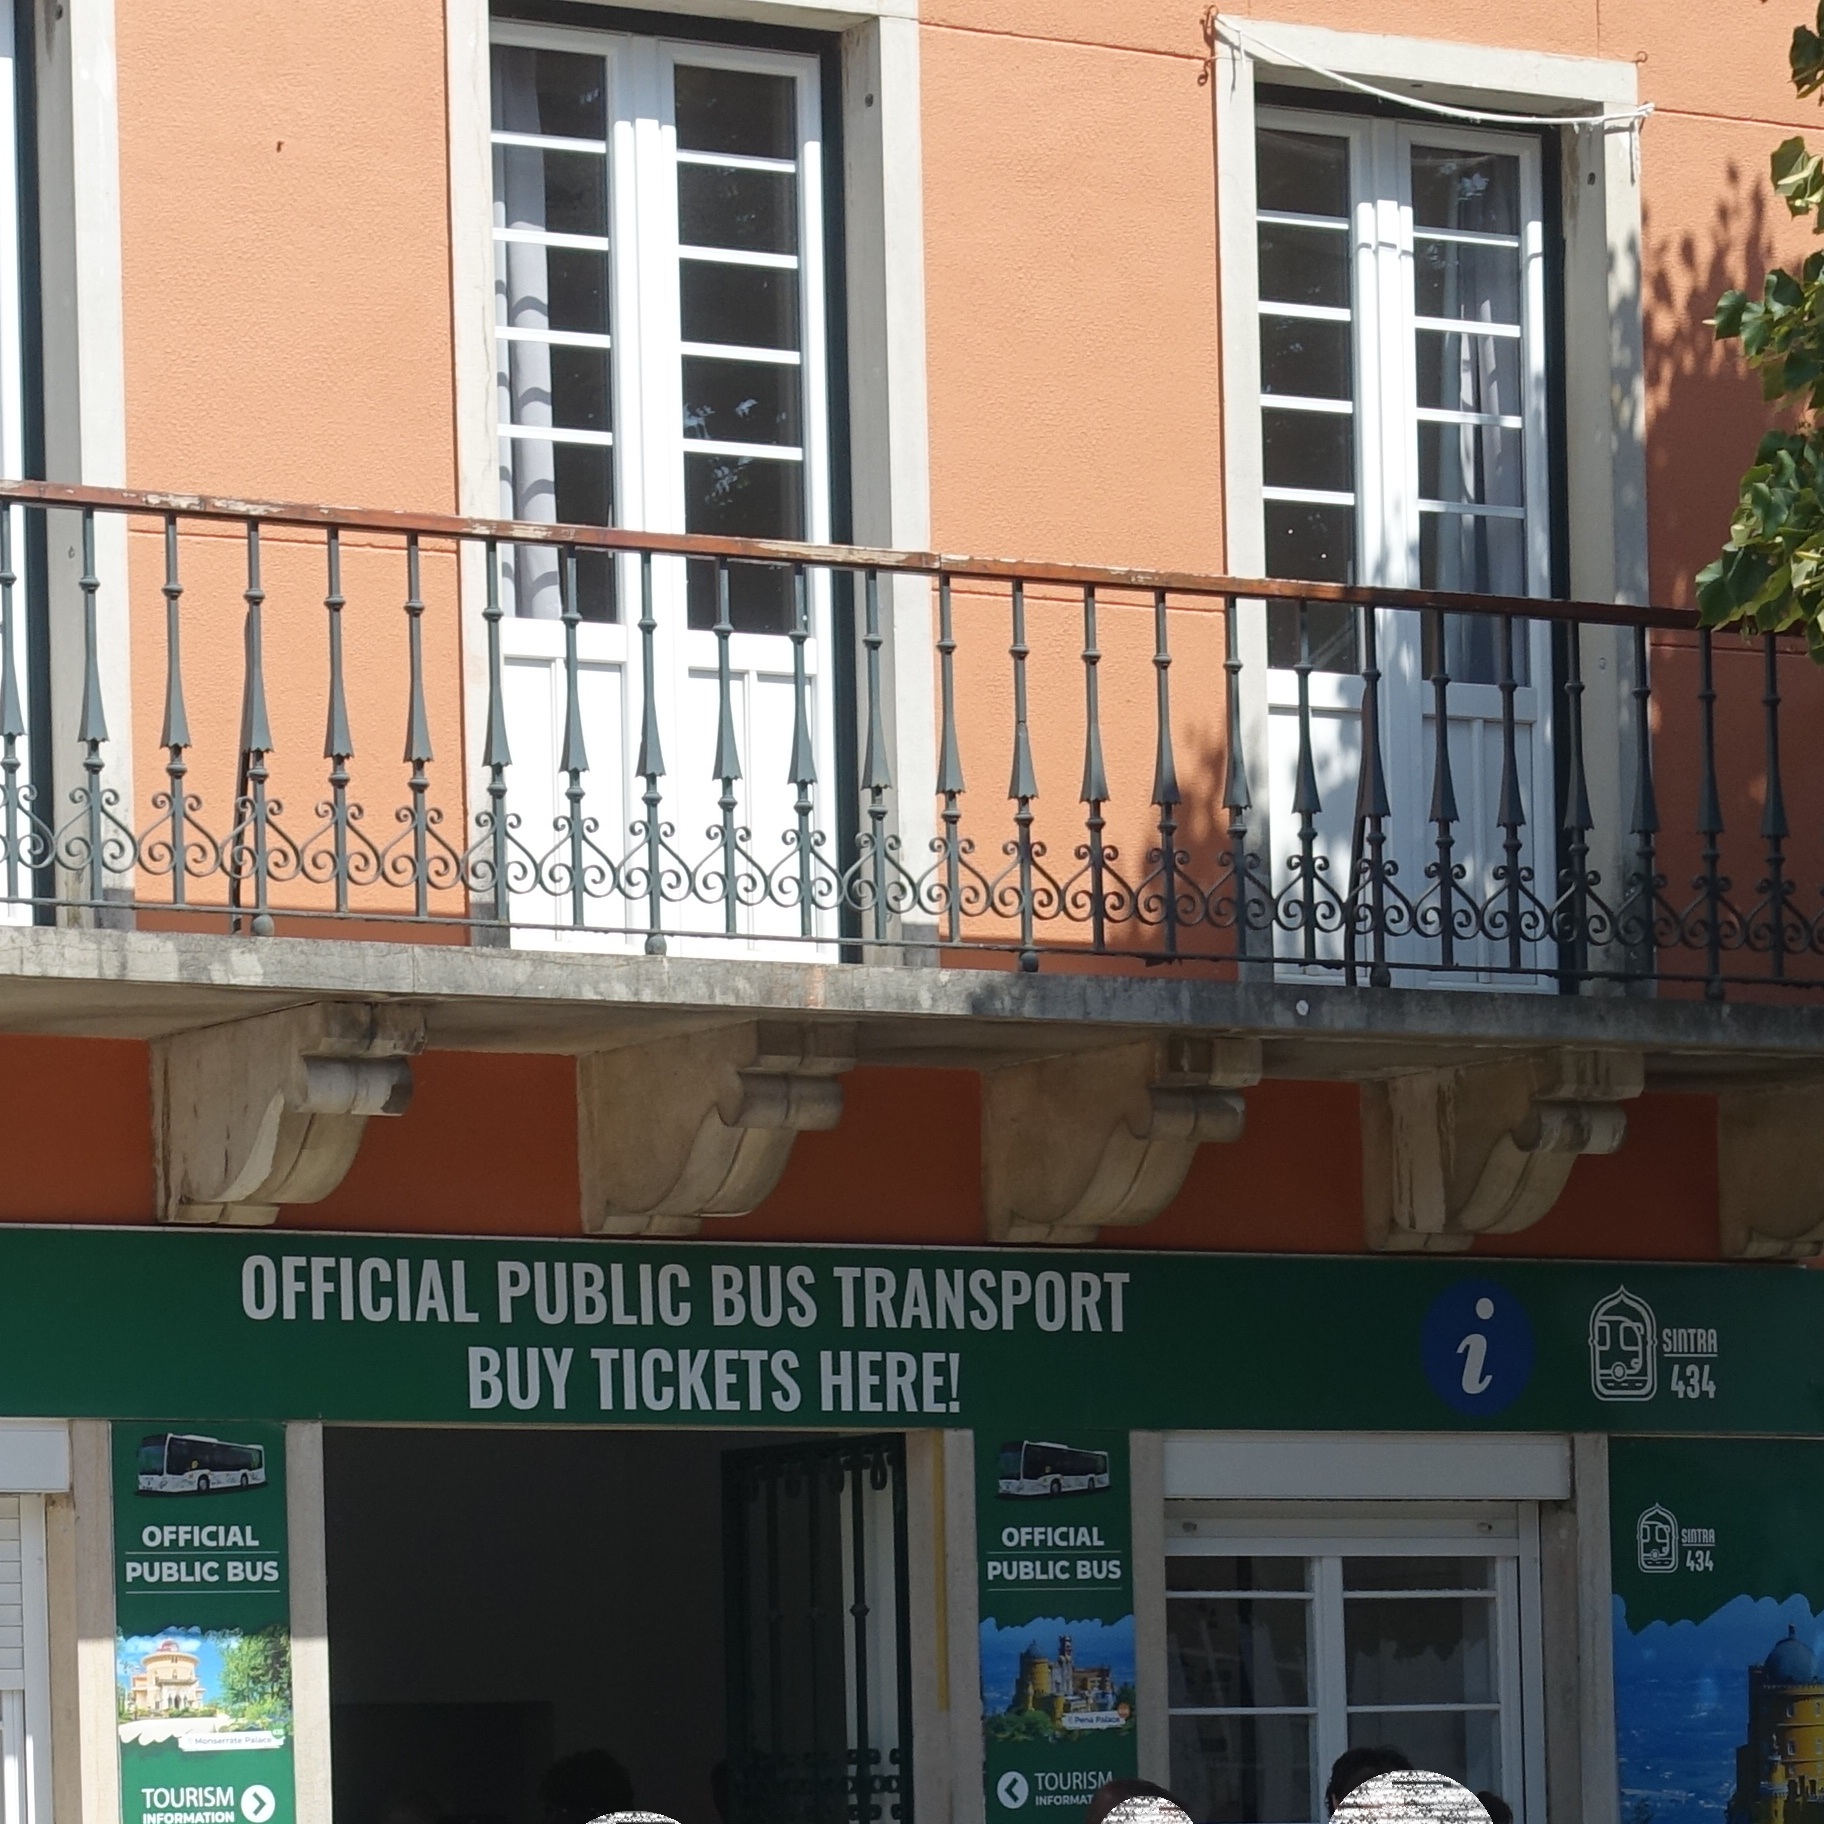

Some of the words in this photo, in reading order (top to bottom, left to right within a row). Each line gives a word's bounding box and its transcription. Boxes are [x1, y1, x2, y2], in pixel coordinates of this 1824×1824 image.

[241, 1255, 480, 1324] OFFICIAL
[498, 1261, 692, 1327] PUBLIC
[712, 1264, 817, 1329] BUS
[833, 1267, 1130, 1334] TRANSPORT
[1662, 1327, 1718, 1353] SINTRA
[468, 1346, 575, 1410] BUY
[590, 1348, 801, 1413] TICKETS
[820, 1350, 960, 1414] HERE!
[1671, 1364, 1717, 1400] 434
[142, 1525, 259, 1547] OFFICIAL
[1002, 1527, 1104, 1546] OFFICIAL
[1681, 1528, 1716, 1545] SINTRA
[126, 1561, 219, 1583] PUBLIC
[227, 1561, 279, 1582] BUS
[987, 1560, 1070, 1580] PUBLIC
[1077, 1560, 1121, 1579] BUS
[1686, 1551, 1714, 1572] 434
[245, 1736, 272, 1744] Palace
[1034, 1771, 1112, 1790] TOURISM
[142, 1786, 234, 1809] TOURISM
[1036, 1794, 1093, 1805] INFORMAT
[142, 1811, 235, 1824] INFORMATION
